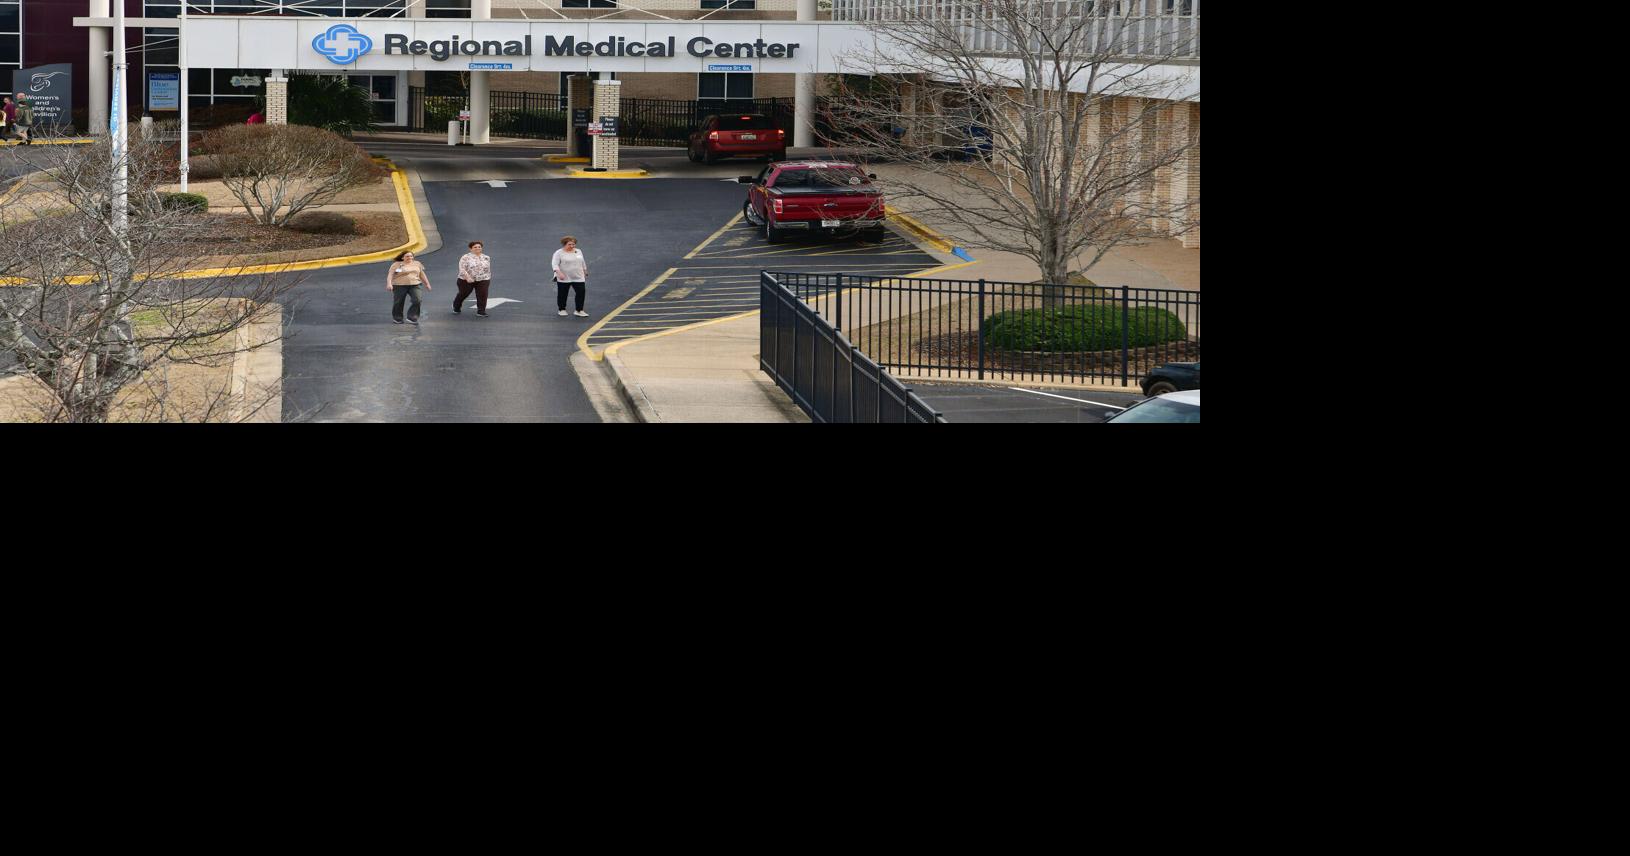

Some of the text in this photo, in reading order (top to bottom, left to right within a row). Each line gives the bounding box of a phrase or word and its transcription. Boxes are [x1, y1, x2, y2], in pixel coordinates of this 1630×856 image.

[385, 34, 799, 61] Regional Medical Center
